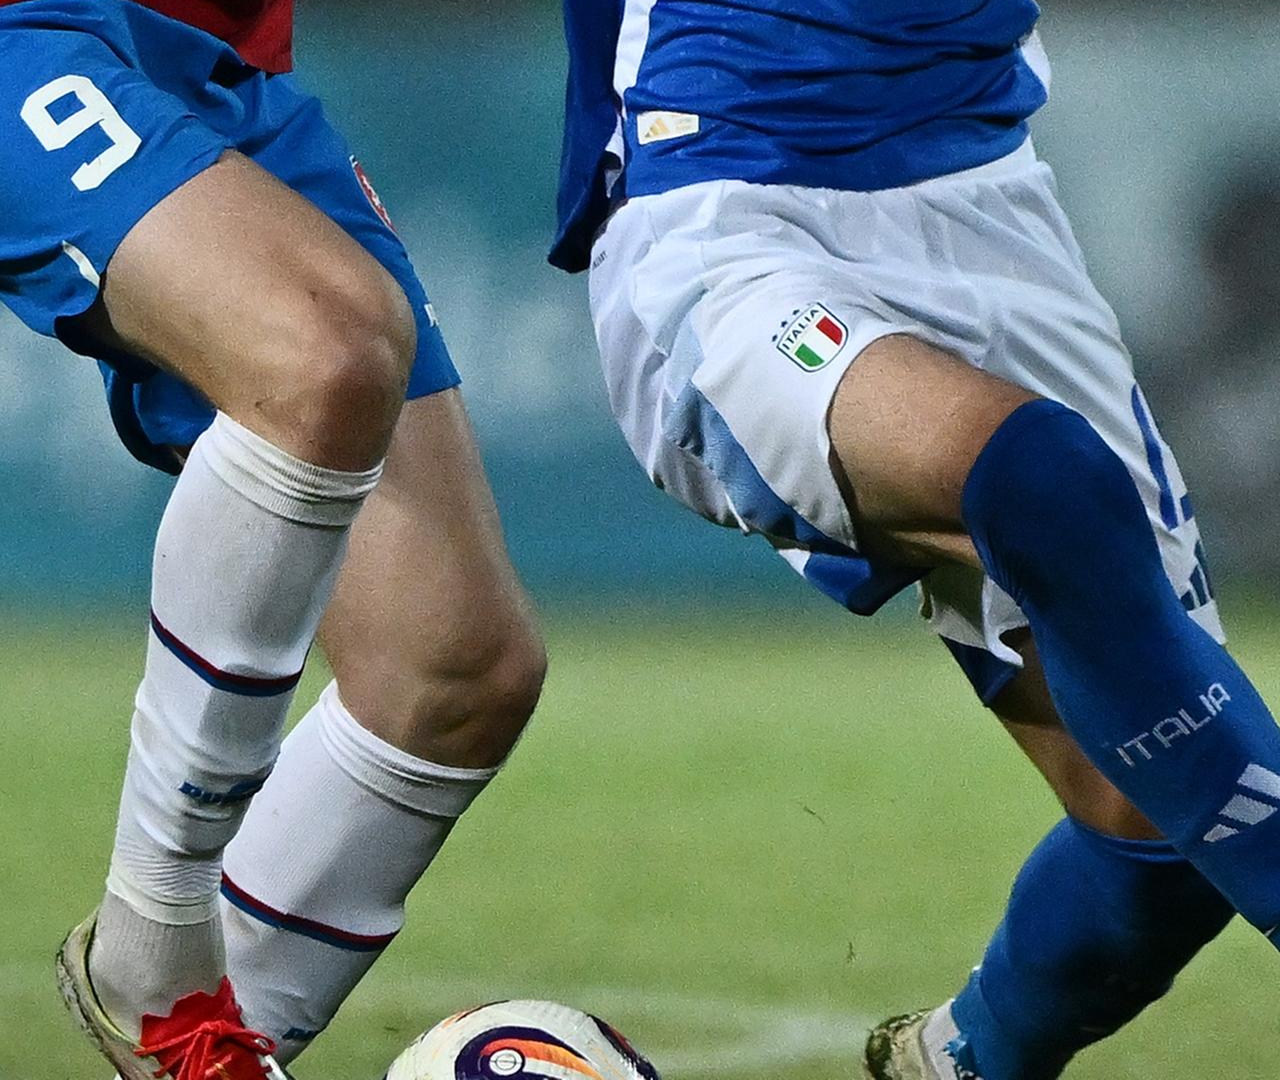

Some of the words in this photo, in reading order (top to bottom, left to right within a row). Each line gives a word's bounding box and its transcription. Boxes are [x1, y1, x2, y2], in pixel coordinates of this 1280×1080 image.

[20, 74, 143, 191] 9
[781, 308, 819, 351] ITALIA
[1116, 682, 1231, 767] ITALIA
